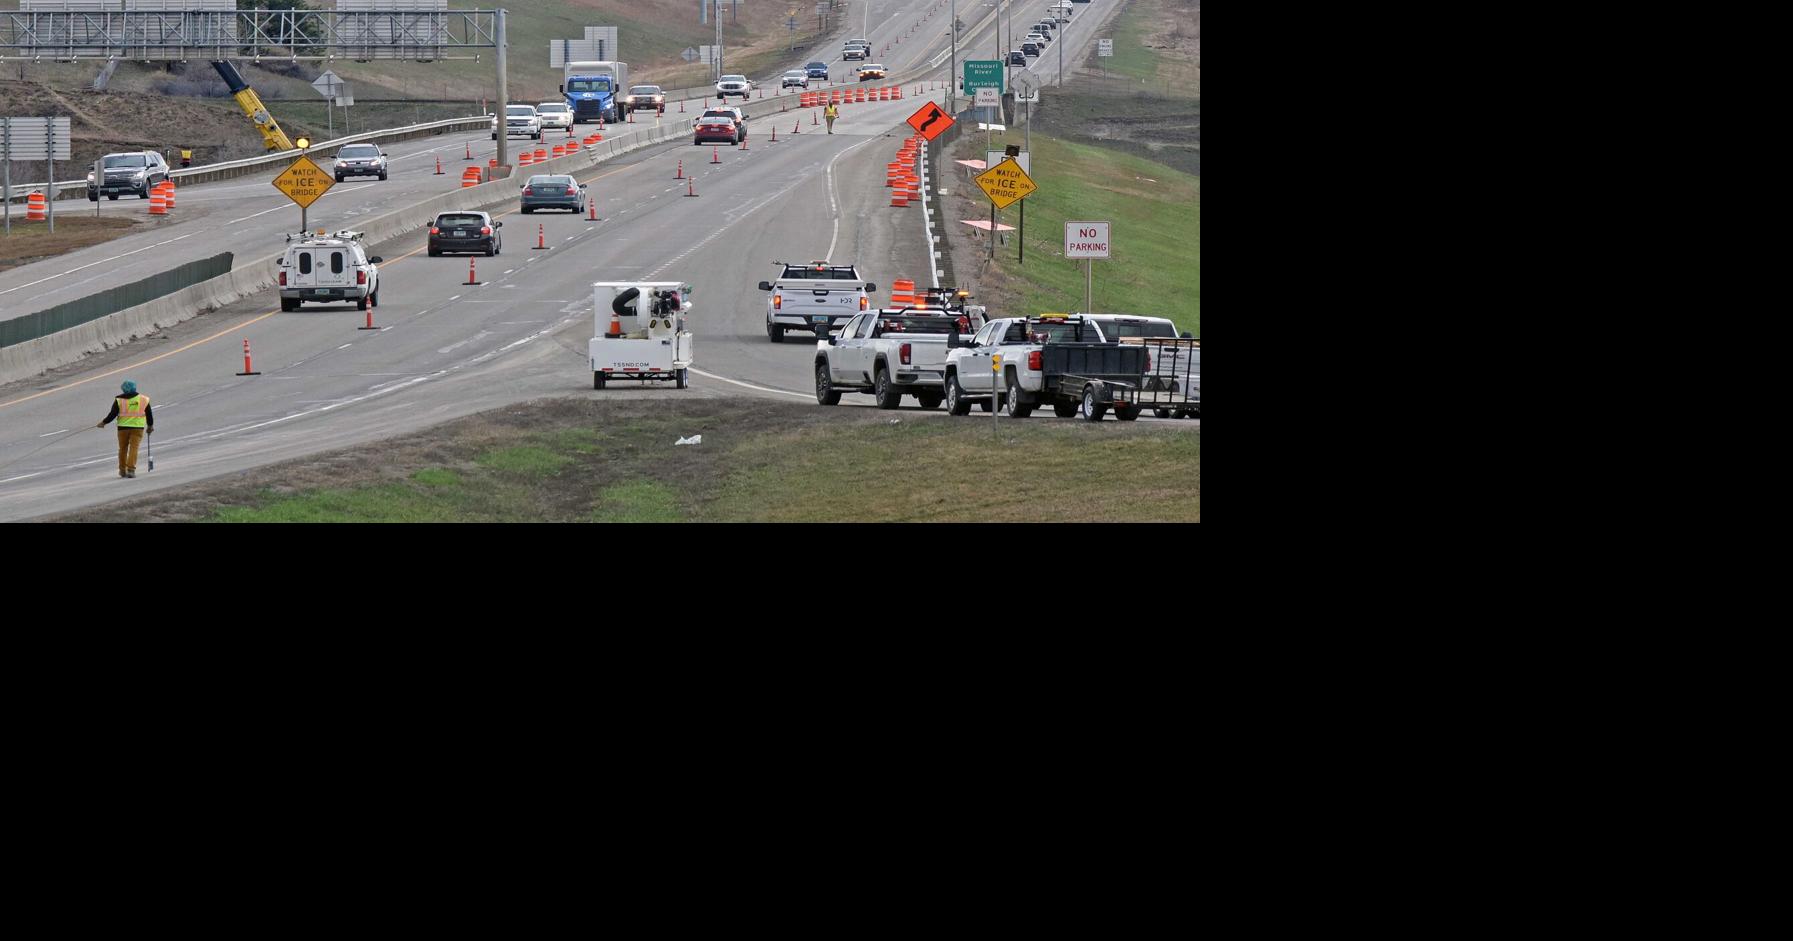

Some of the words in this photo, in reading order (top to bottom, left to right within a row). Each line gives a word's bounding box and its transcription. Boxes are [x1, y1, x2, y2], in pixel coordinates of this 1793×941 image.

[291, 168, 317, 176] WATCH
[996, 169, 1021, 179] WATCH
[296, 178, 315, 187] ICE
[997, 178, 1017, 189] ICE
[290, 188, 319, 196] BRIDGE
[989, 188, 1018, 199] BRIDGE
[1079, 228, 1097, 238] NO
[1069, 242, 1107, 252] PARKING
